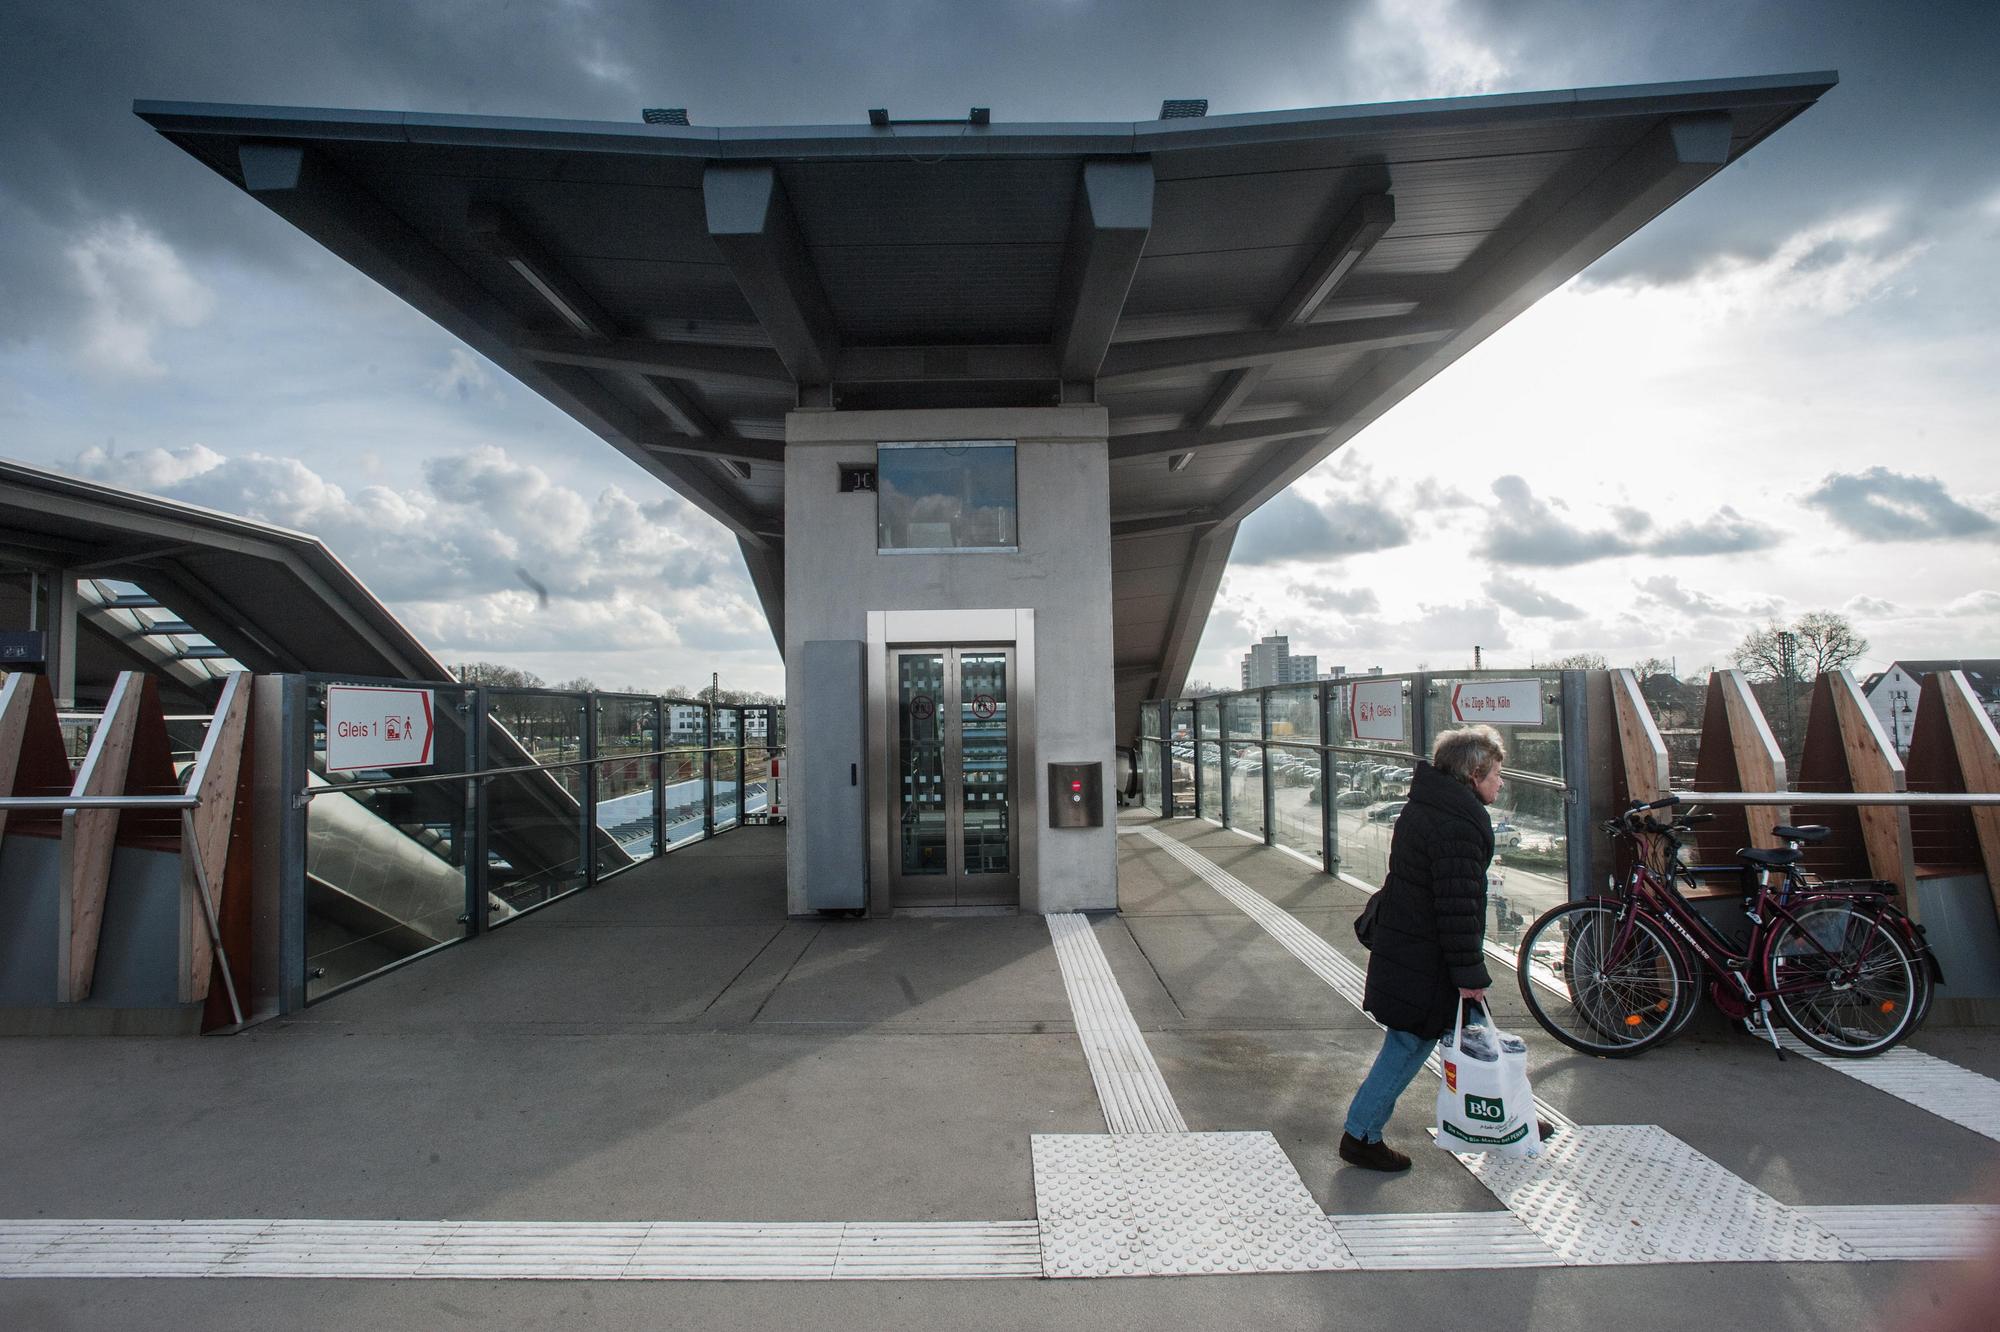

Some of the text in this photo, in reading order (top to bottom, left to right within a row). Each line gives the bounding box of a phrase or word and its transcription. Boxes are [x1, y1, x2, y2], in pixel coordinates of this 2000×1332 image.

[1377, 704, 1392, 717] Gleis
[1472, 696, 1484, 711] Züge
[1498, 695, 1511, 708] Köln
[338, 721, 378, 738] Gleis 1
[1664, 912, 1696, 946] KETTLER
